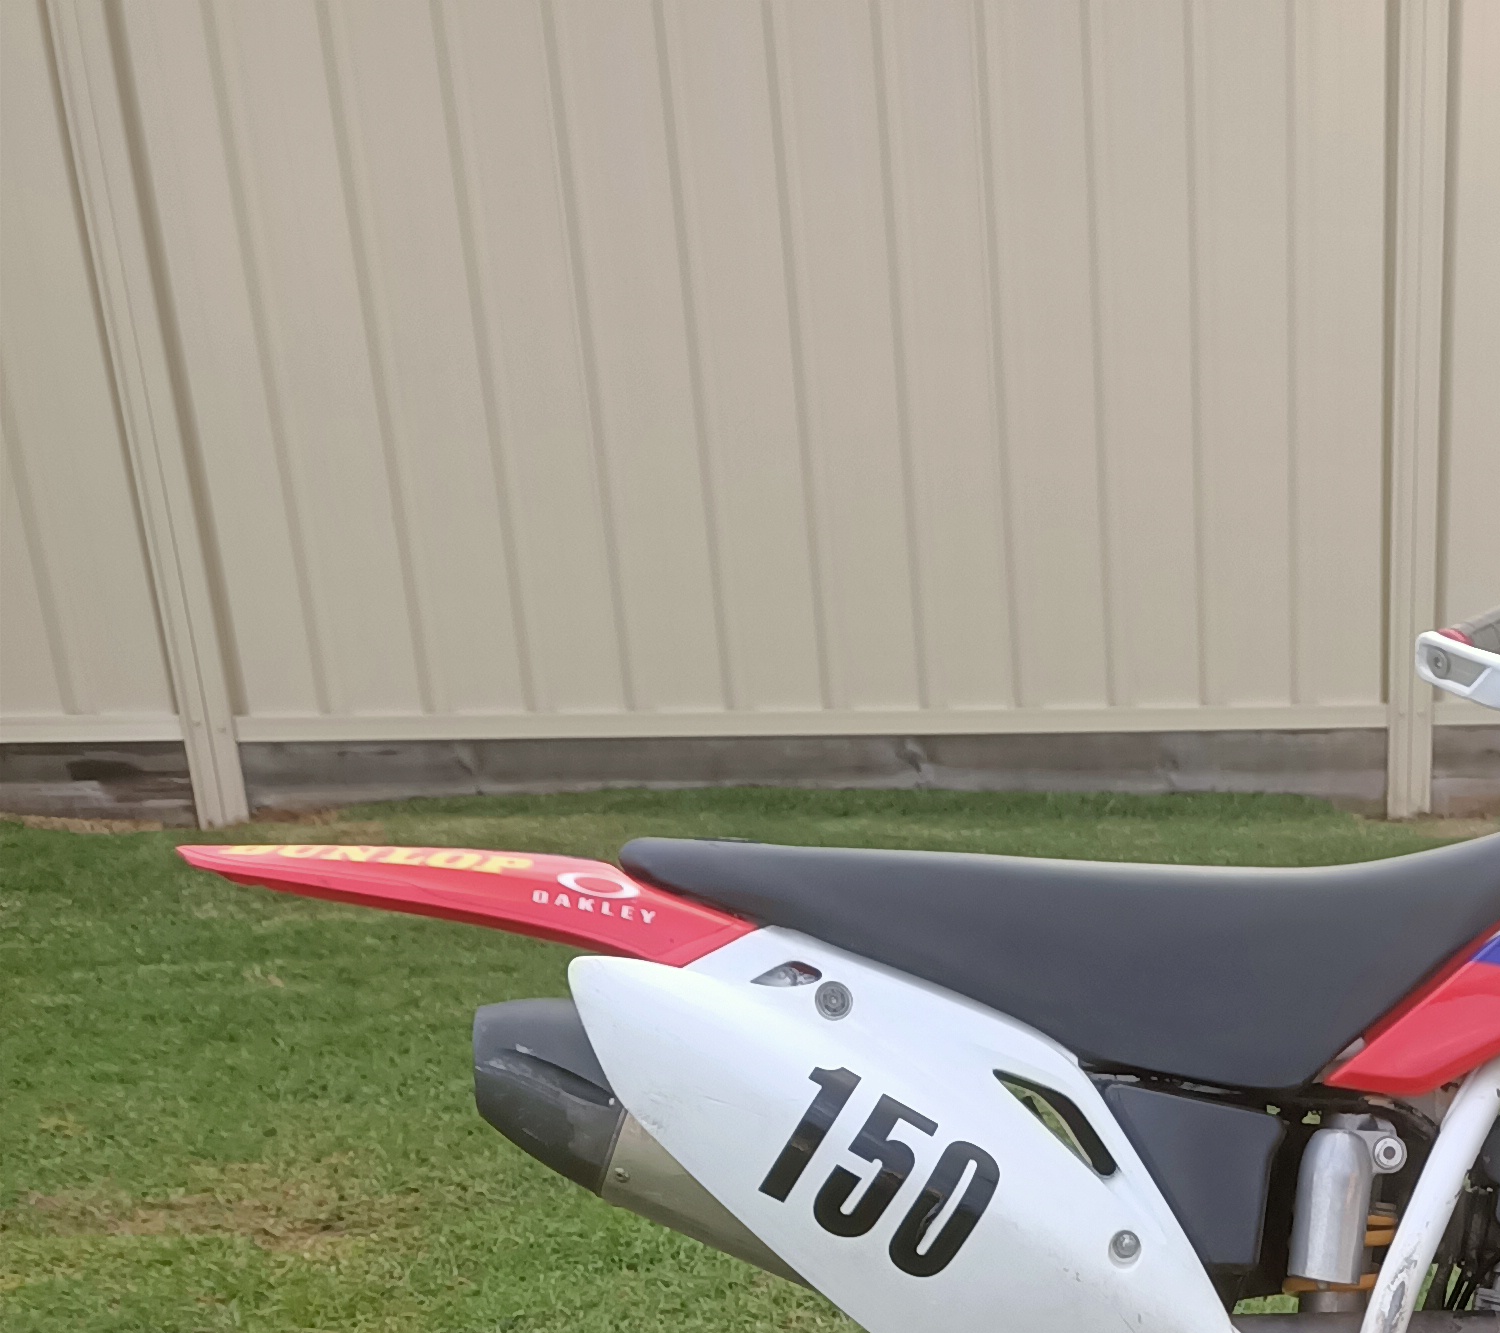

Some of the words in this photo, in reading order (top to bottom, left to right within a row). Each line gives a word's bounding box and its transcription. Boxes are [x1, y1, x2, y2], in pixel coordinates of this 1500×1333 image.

[217, 844, 534, 874] DUNLOP
[531, 889, 657, 925] OAKLEY
[757, 1065, 1001, 1278] 150
